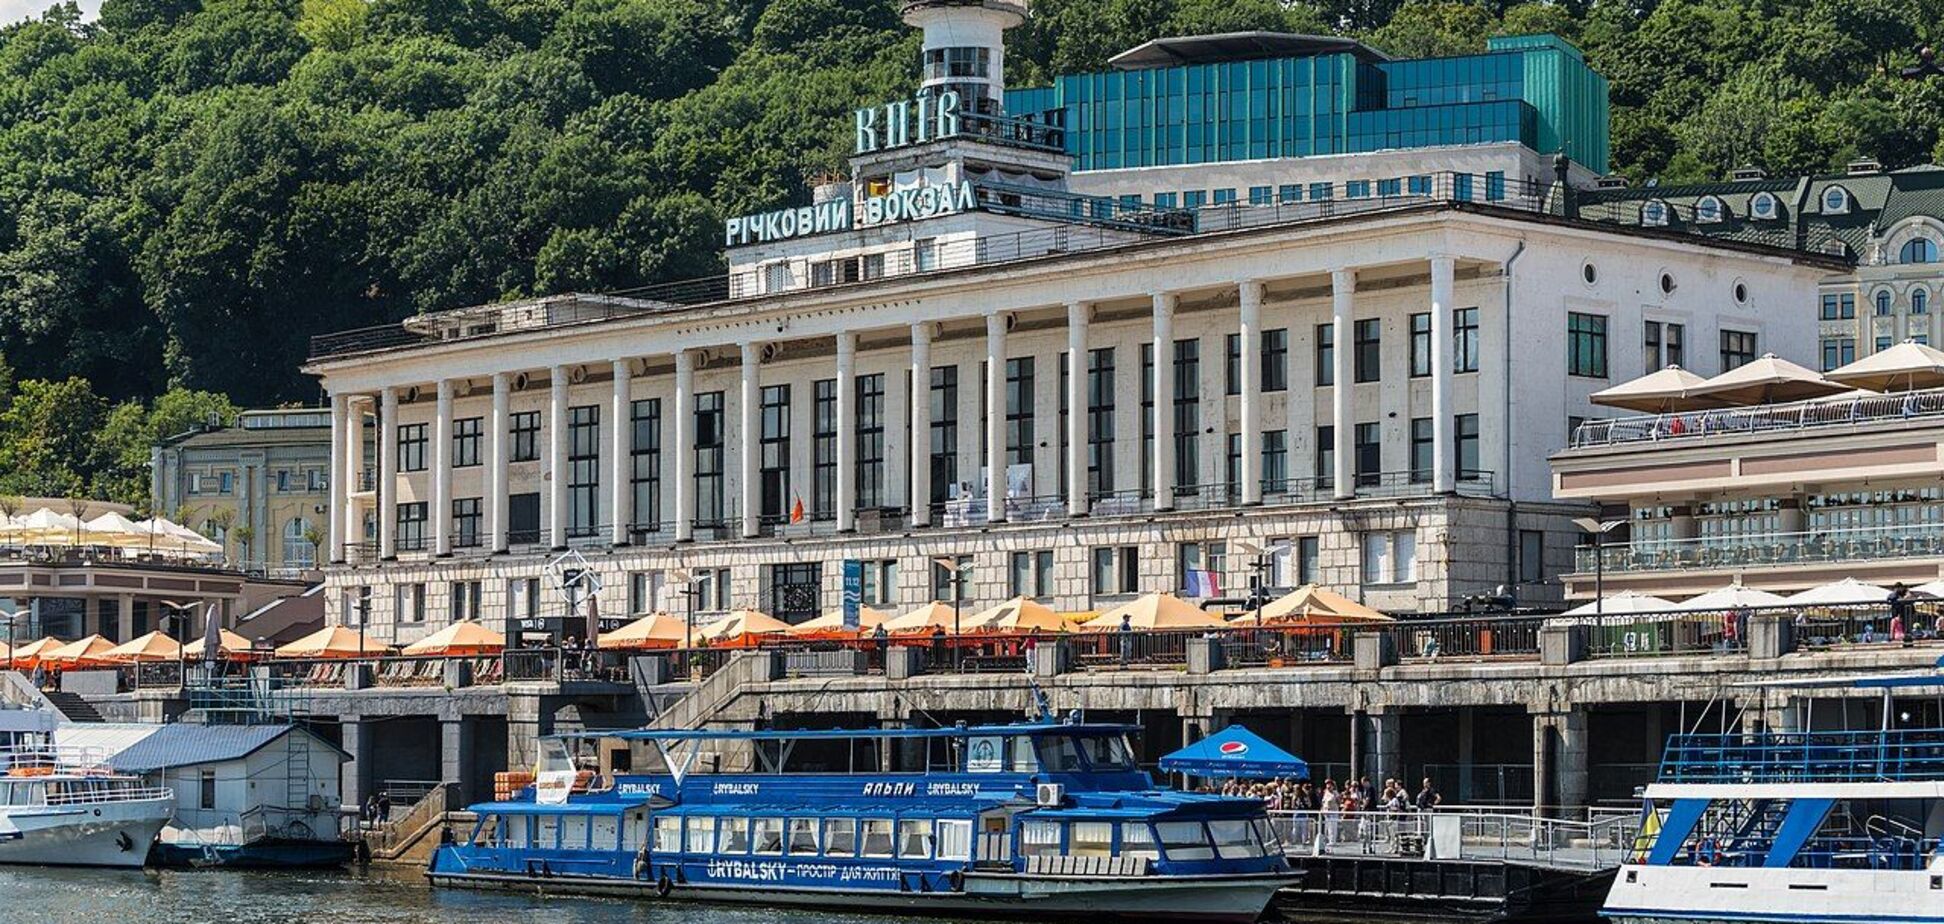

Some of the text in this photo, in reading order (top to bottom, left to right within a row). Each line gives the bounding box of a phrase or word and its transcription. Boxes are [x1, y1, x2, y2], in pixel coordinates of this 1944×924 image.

[854, 87, 961, 155] КИЇВ
[726, 180, 977, 246] РІЧКОВИЙ ВОКЗАЛ
[622, 783, 661, 794] RYBALSKY
[718, 783, 759, 795] RYBALSKY
[932, 783, 980, 796] RYBALSKY
